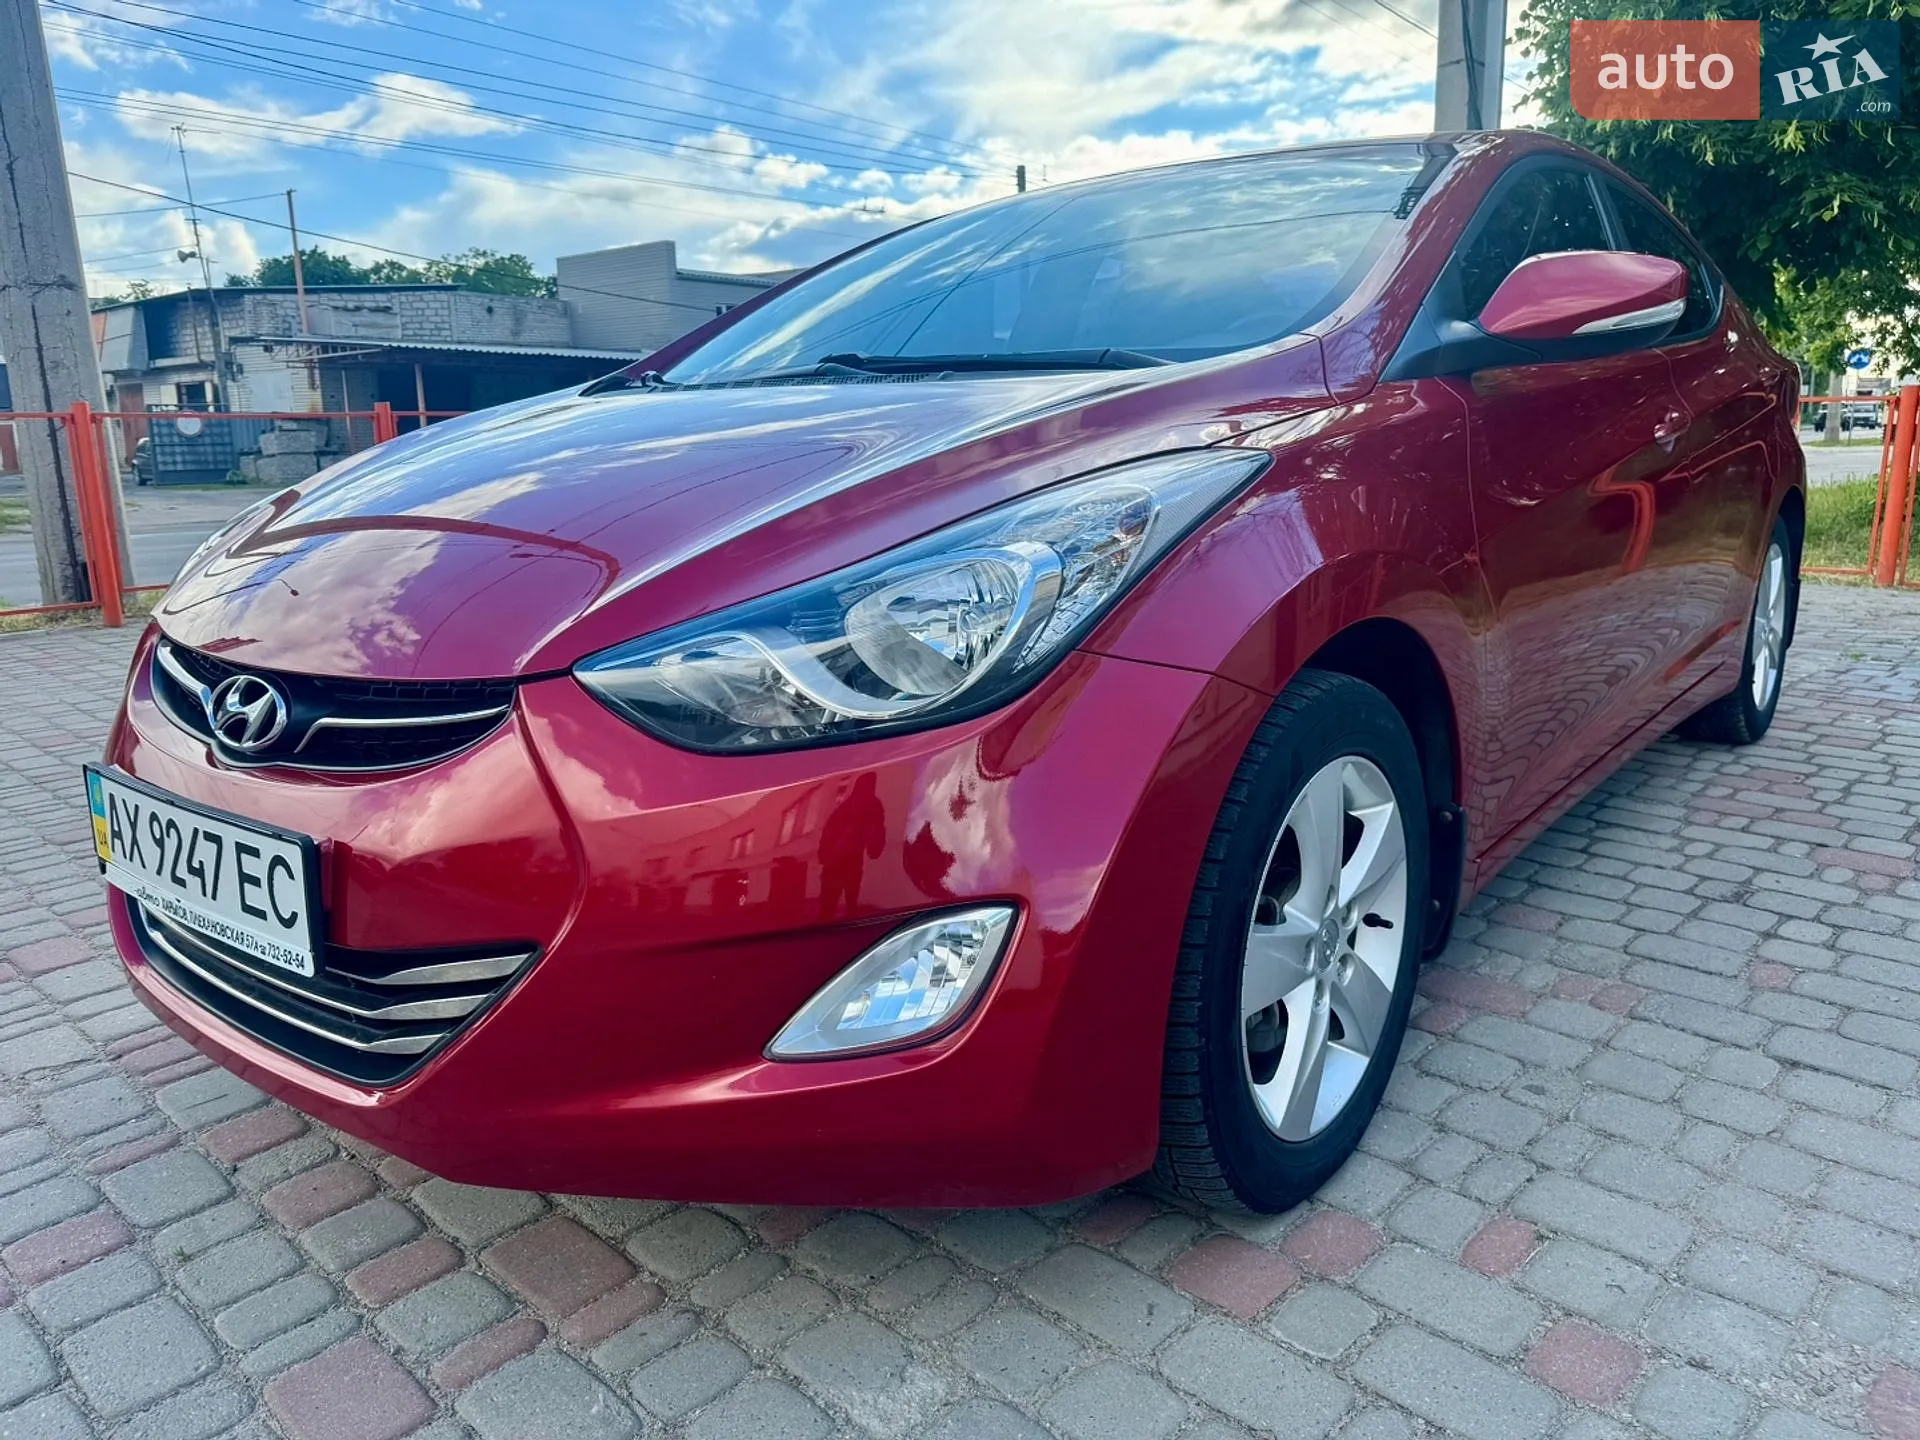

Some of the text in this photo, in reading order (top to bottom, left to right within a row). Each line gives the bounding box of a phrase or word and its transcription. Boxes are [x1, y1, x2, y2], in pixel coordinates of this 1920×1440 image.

[109, 792, 299, 929] AX 9247 EC
[267, 942, 305, 970] 732-52-54
